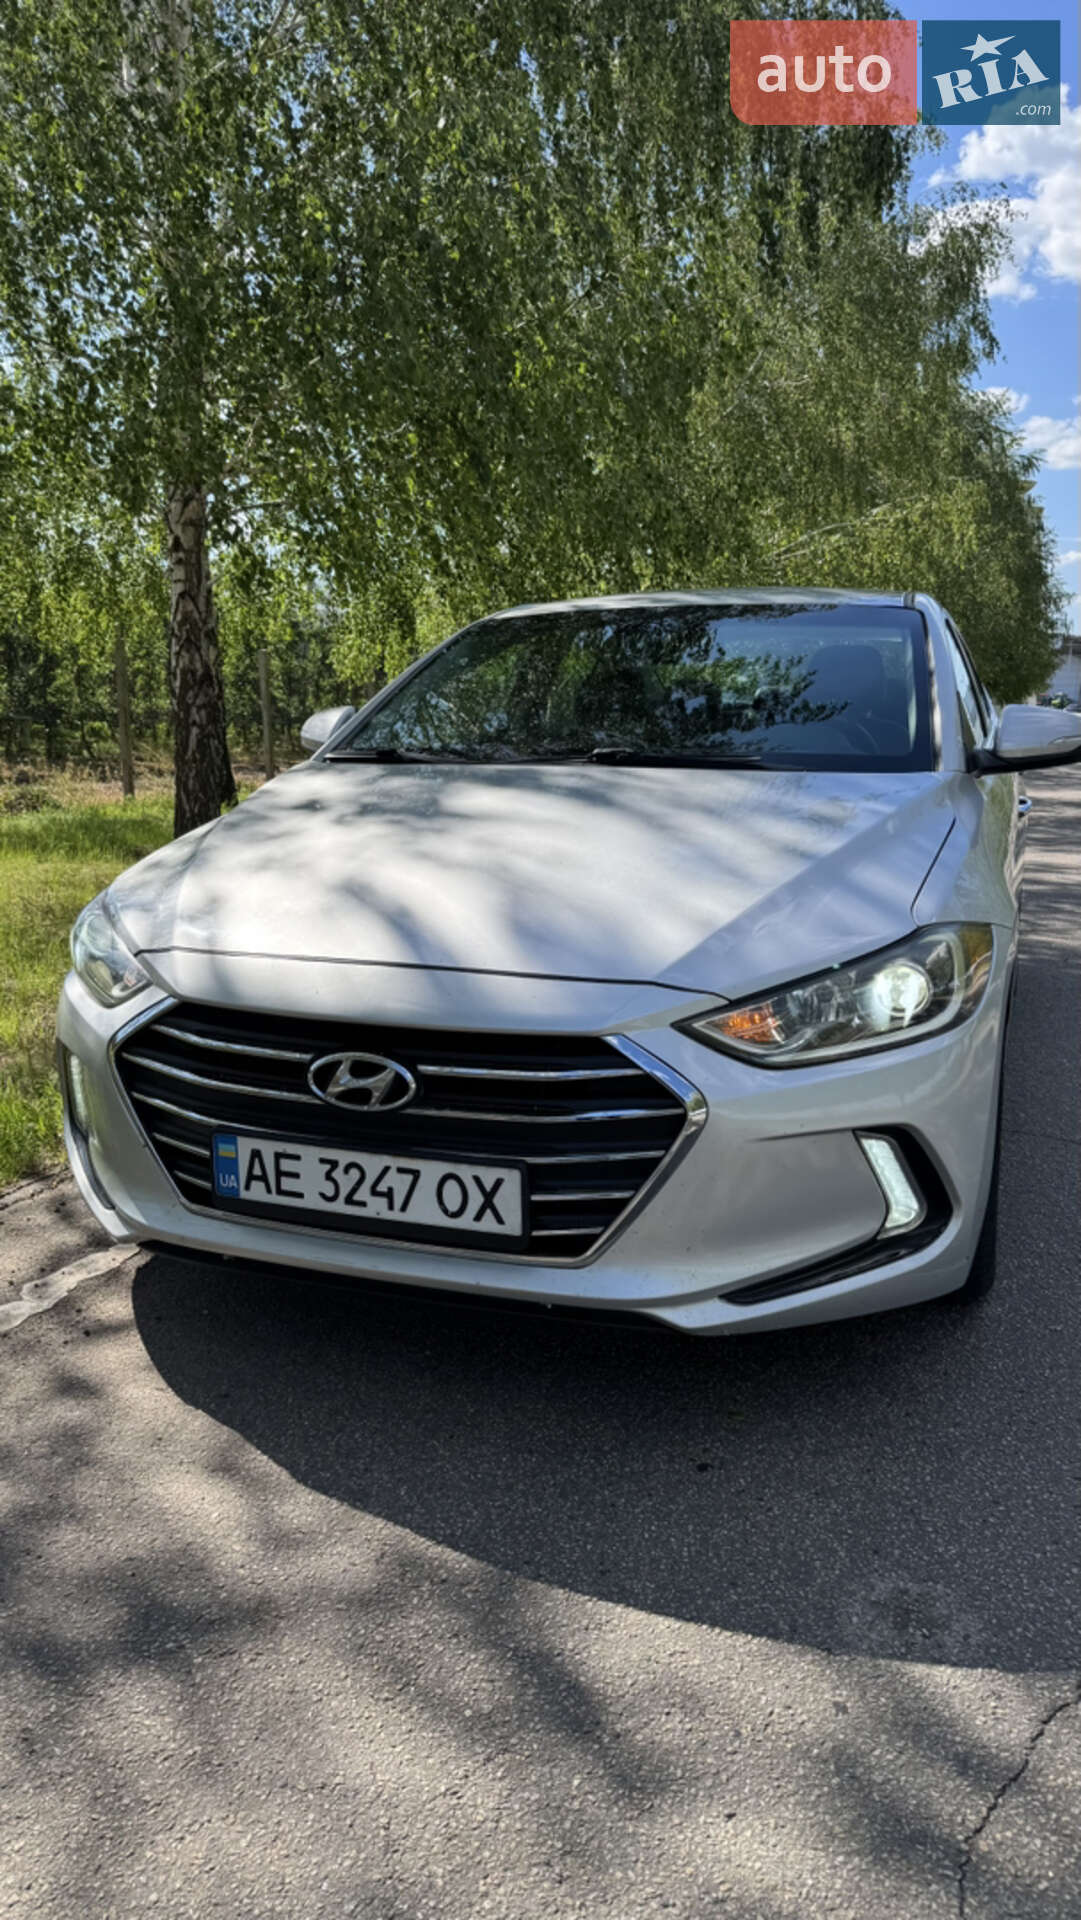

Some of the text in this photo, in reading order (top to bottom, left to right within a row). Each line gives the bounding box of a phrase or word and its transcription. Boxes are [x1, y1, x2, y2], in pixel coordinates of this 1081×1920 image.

[219, 1173, 238, 1189] UA
[244, 1148, 505, 1226] AE 3247 OX
